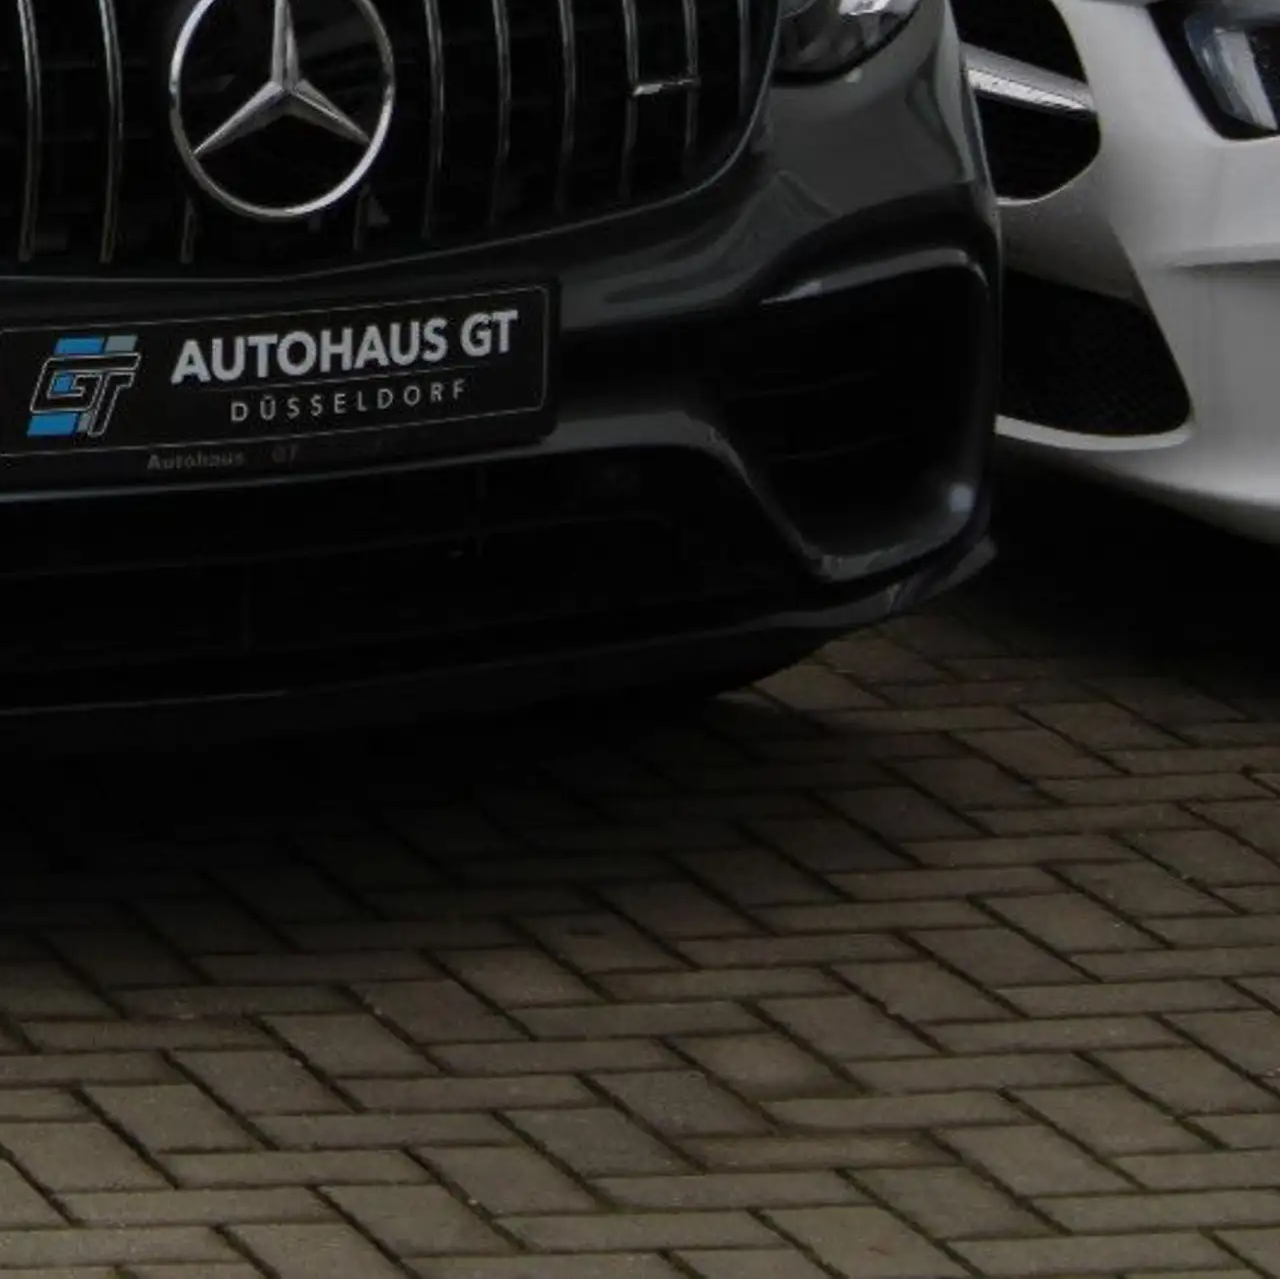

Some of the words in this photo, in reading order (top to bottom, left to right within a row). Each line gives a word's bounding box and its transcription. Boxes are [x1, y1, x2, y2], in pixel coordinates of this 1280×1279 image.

[170, 319, 450, 386] AUTOHAUS
[460, 309, 520, 357] GT
[230, 377, 468, 423] DÜSSELDORF
[146, 449, 245, 471] Autohaus
